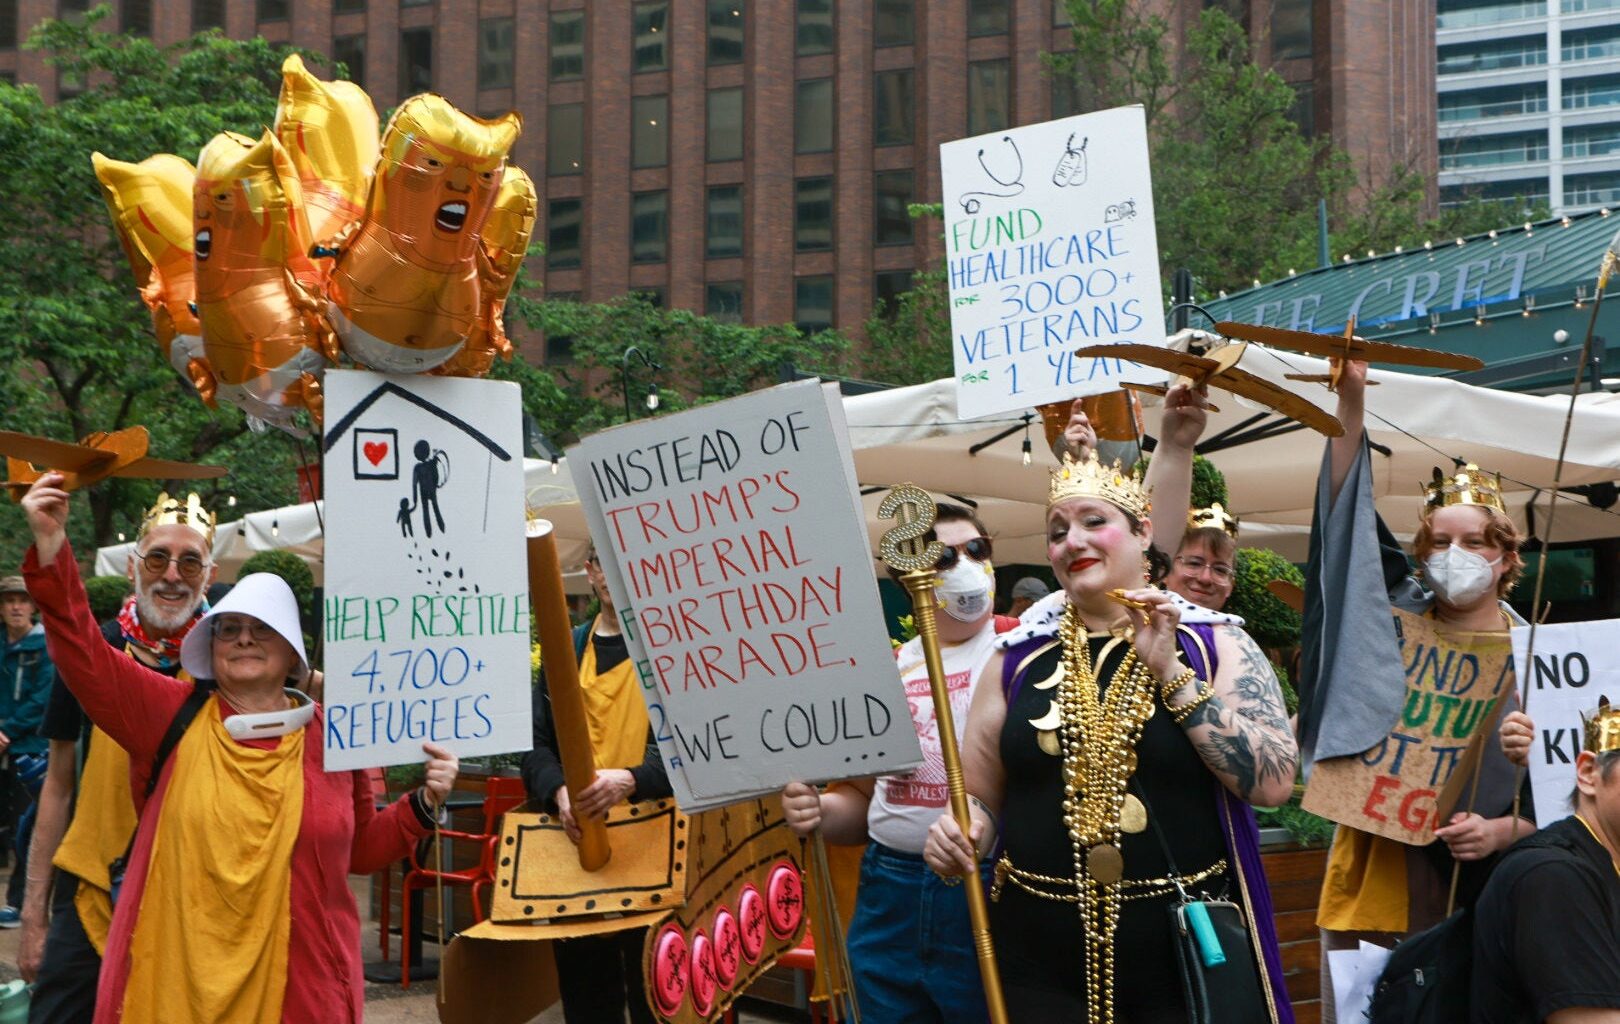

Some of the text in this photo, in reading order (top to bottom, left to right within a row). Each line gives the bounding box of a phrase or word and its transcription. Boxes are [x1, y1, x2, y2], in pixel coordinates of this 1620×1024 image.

[951, 224, 1130, 290] HEALTHCARE
[953, 208, 1043, 252] FUND
[955, 268, 1136, 320] FOR 3000+
[960, 299, 1143, 364] VETERANS
[961, 370, 989, 385] FOR
[1004, 363, 1024, 395] 1
[591, 411, 810, 503] INSTEAD OF
[606, 470, 800, 553] TRUMP'S
[627, 525, 813, 599] IMPERIAL
[325, 592, 528, 643] HELP RESETTLE
[640, 566, 842, 649] BIRTHDAY
[1398, 639, 1480, 696] UND
[1533, 651, 1590, 690] NO
[327, 693, 492, 750] REFUGEES
[675, 714, 739, 762] WE
[1402, 686, 1497, 739] UTU
[910, 784, 949, 802] PALEST
[1362, 775, 1441, 833] EG
